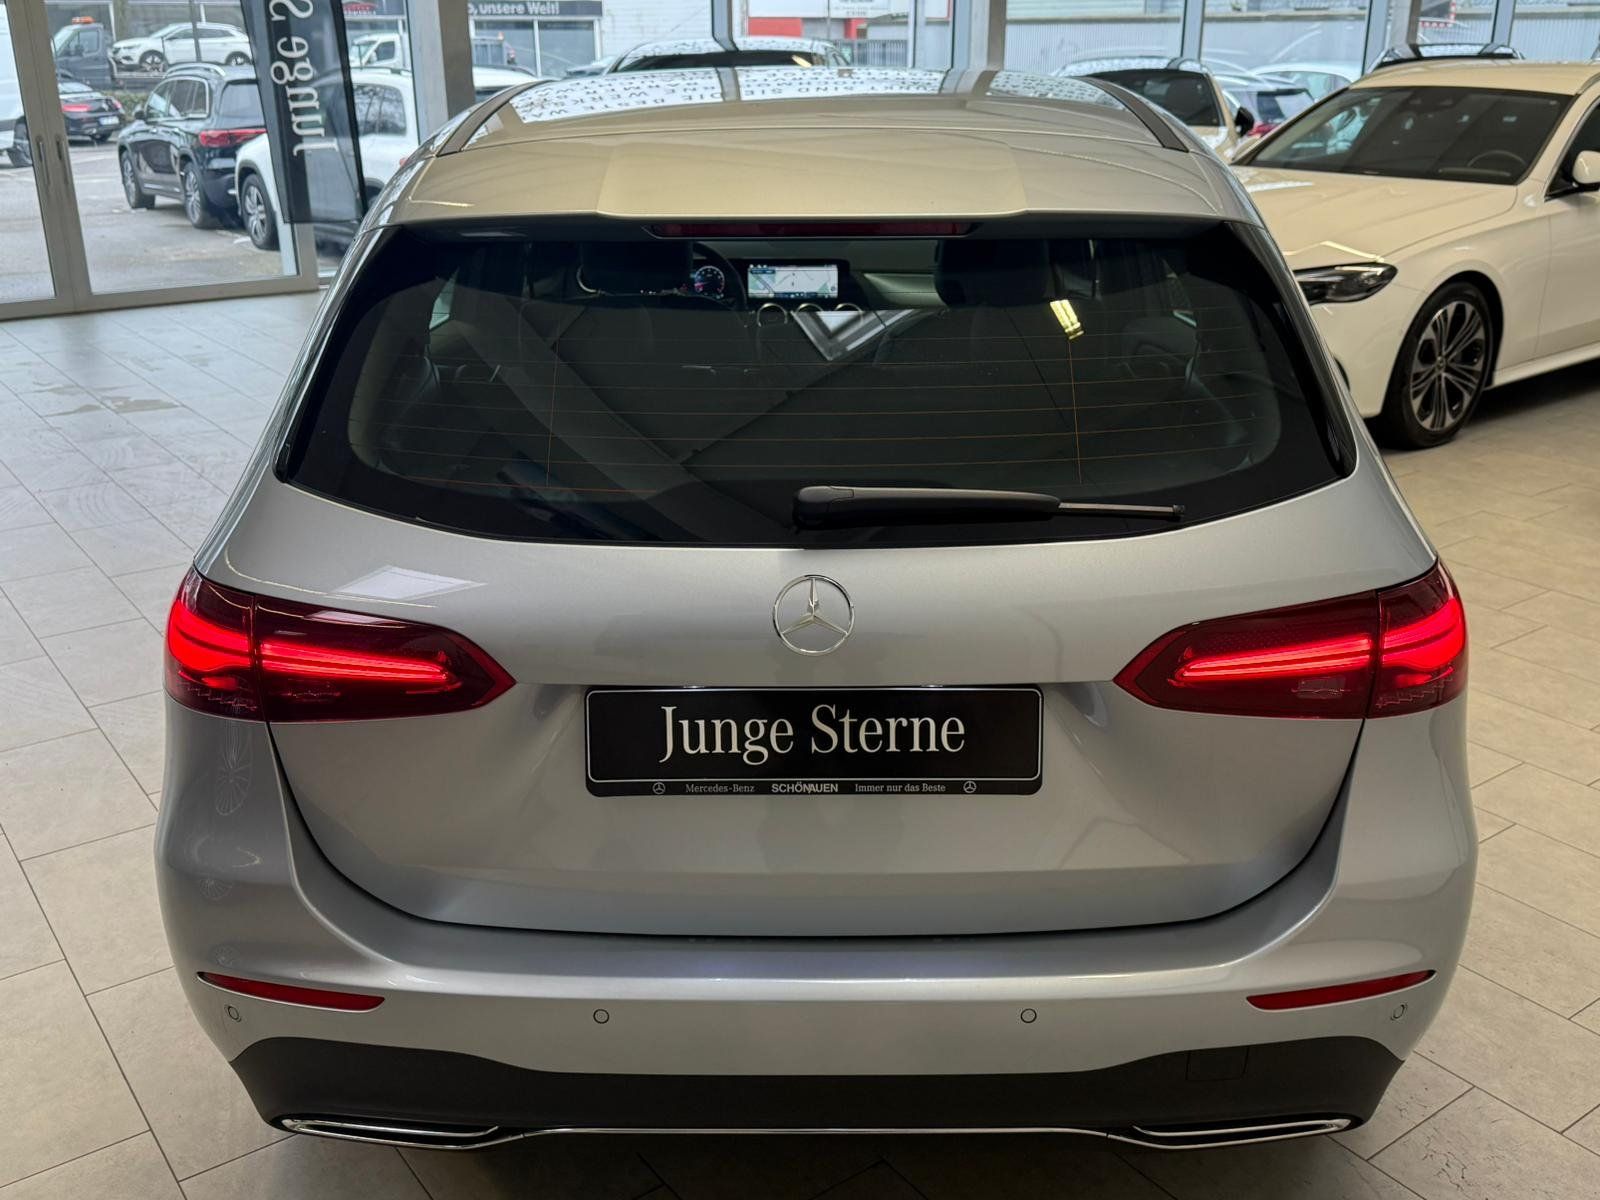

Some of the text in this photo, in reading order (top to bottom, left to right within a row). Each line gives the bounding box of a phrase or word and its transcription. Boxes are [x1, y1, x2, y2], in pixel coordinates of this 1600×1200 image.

[478, 3, 526, 15] unsere
[658, 703, 966, 766] Junge Sterne
[685, 781, 946, 793] Mercedes-Benz SCHÖNAUEN Immer nur das Beste
